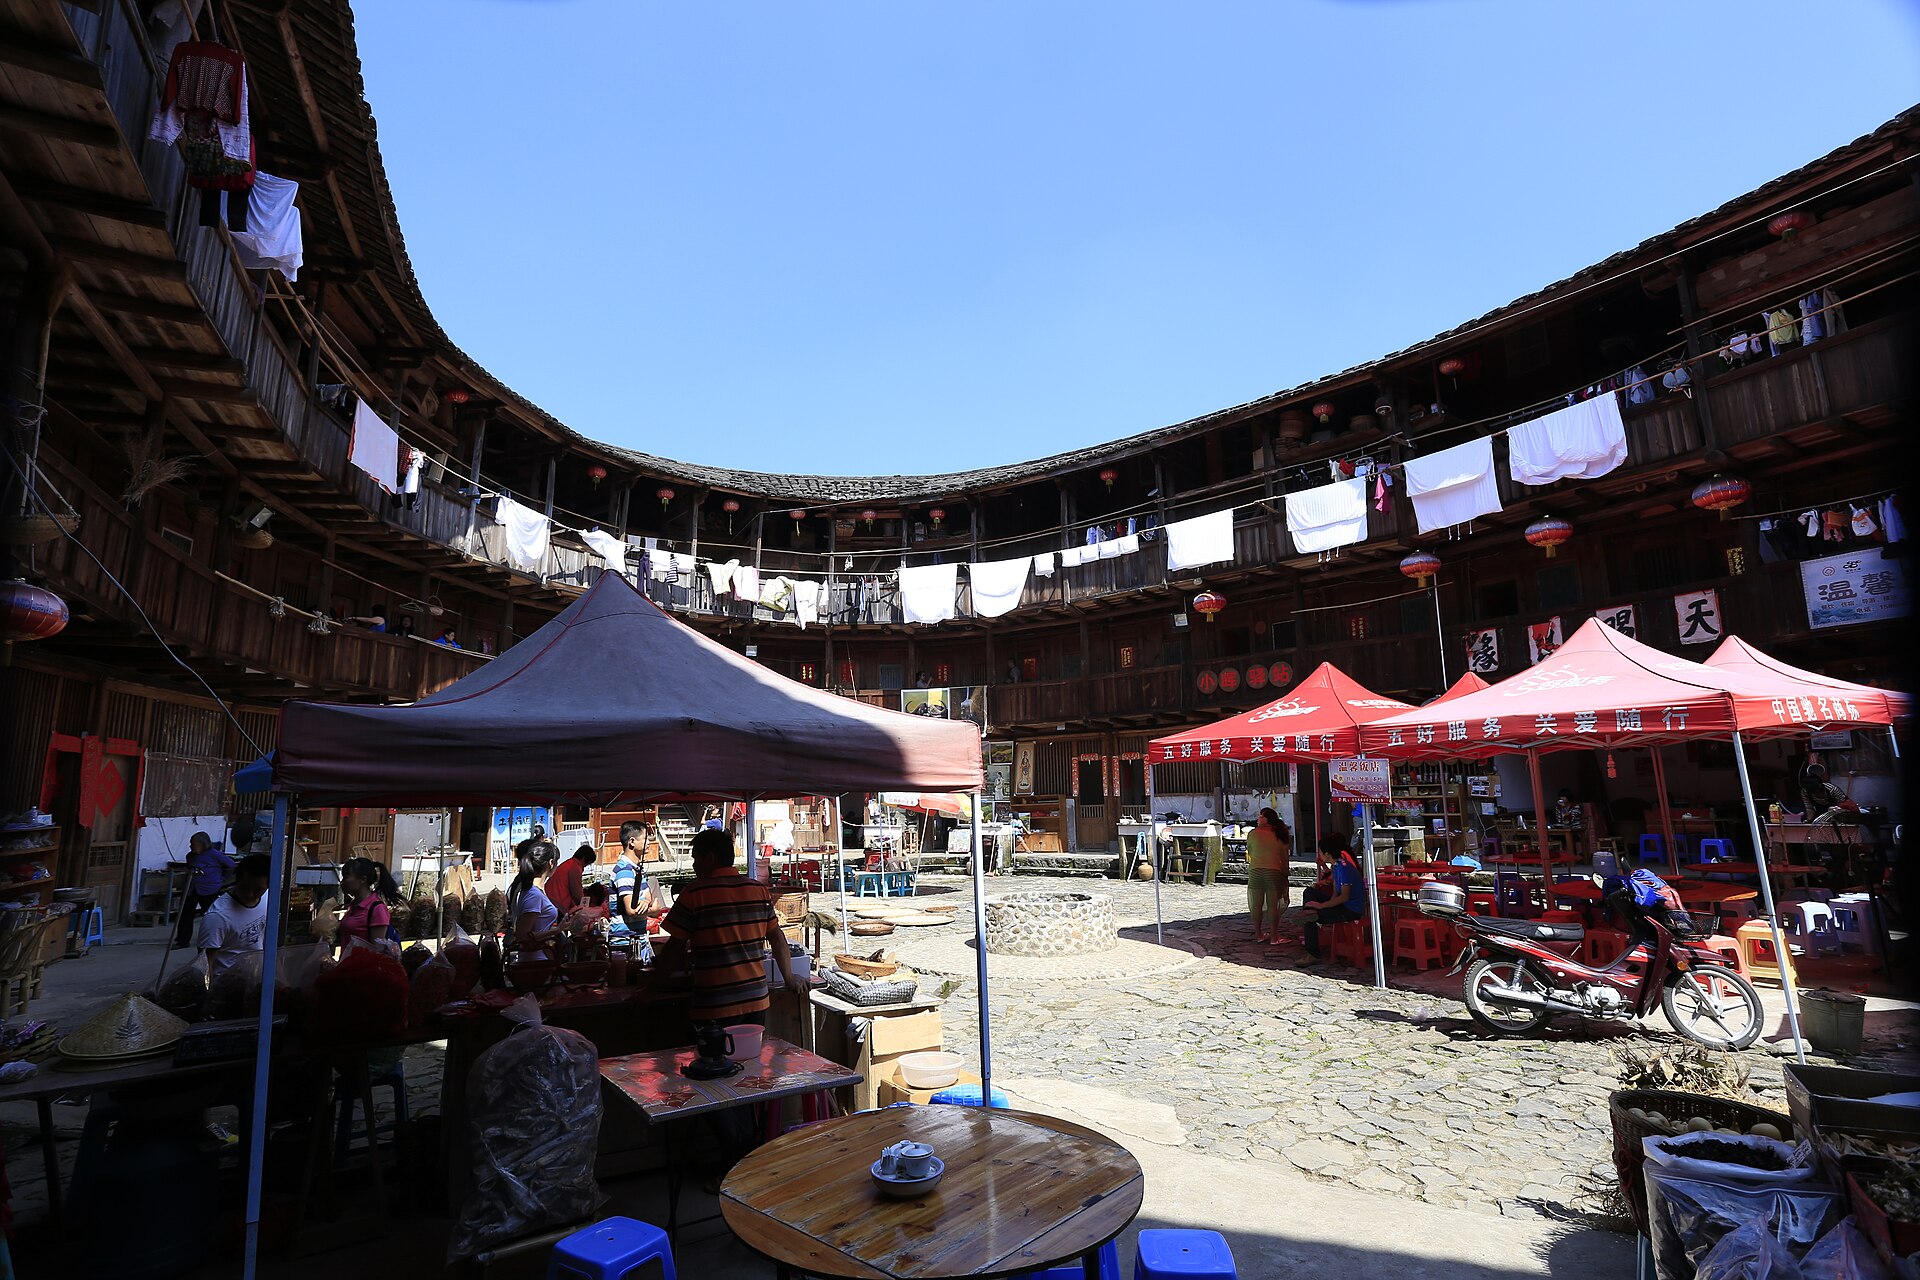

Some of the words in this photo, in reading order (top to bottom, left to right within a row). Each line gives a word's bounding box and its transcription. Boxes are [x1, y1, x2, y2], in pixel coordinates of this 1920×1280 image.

[1682, 598, 1718, 638] 天
[1771, 696, 1860, 723] 中国驰名商标
[1387, 717, 1502, 747] 五好服务
[1535, 706, 1690, 736] 关爱随行
[1163, 738, 1232, 760] 五好服务
[1250, 733, 1335, 753] 关爱随行
